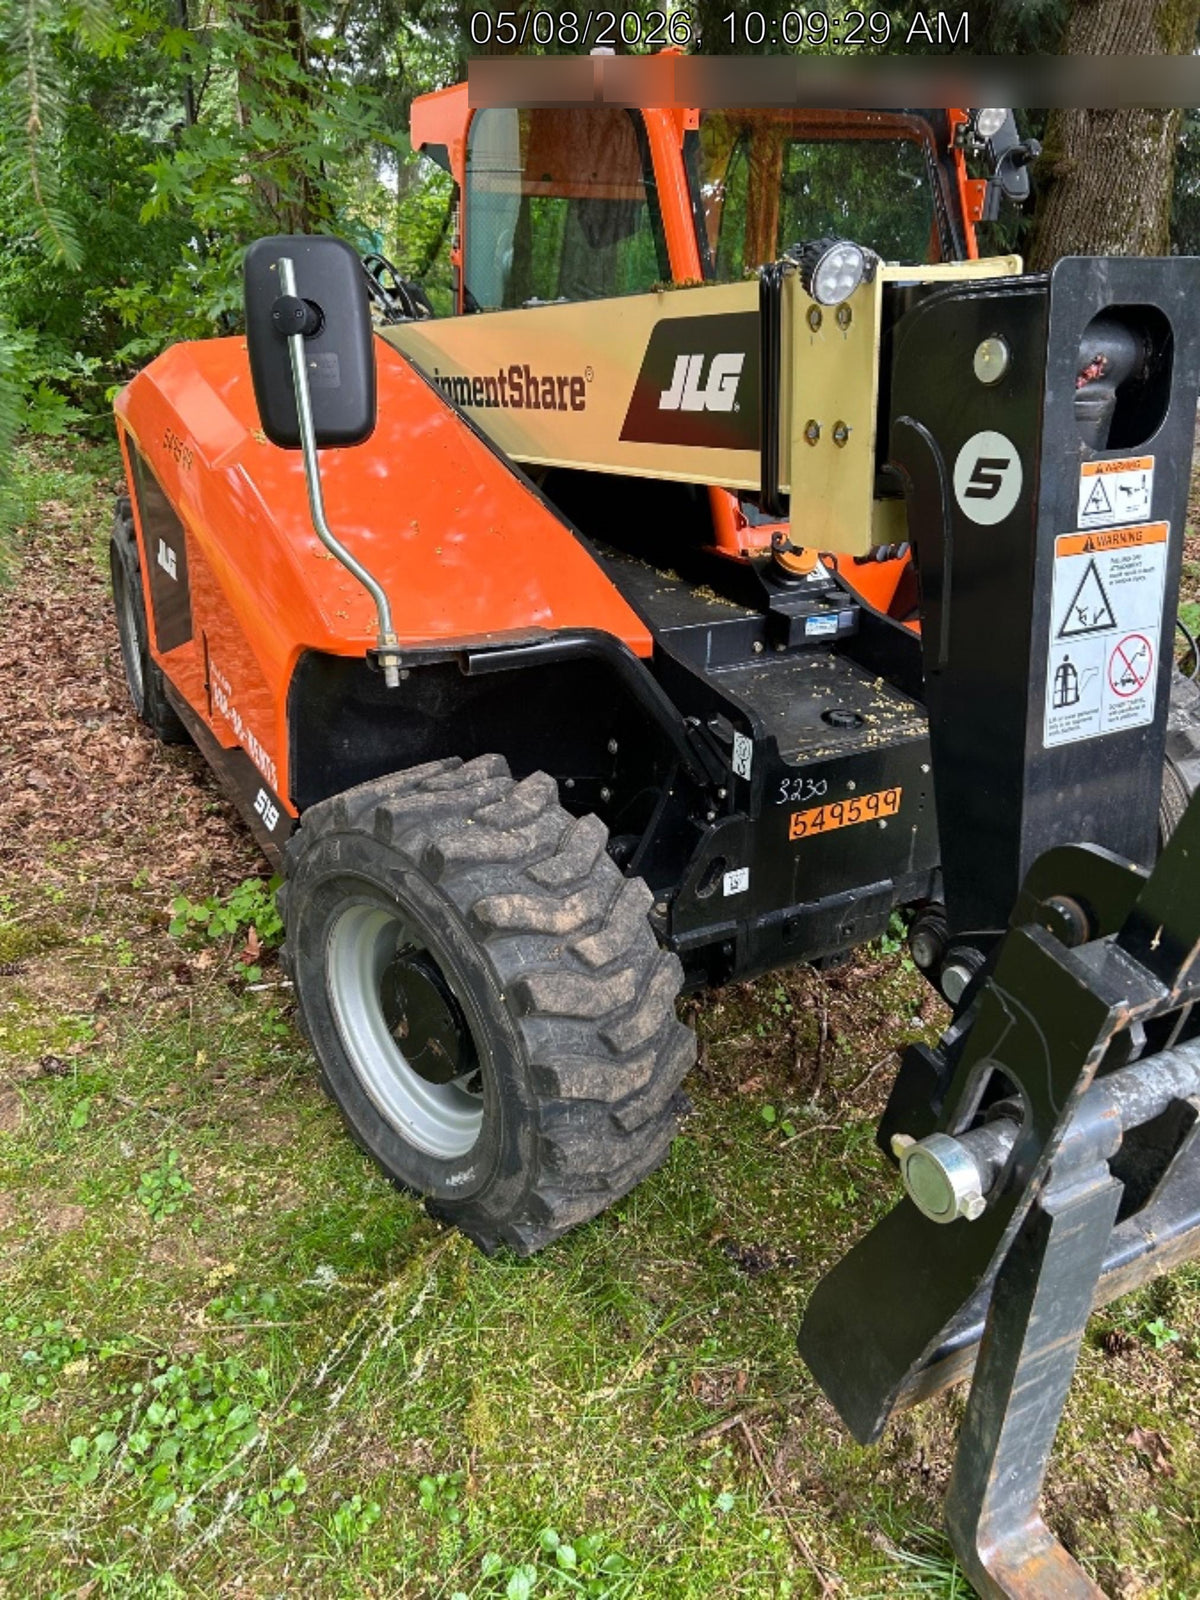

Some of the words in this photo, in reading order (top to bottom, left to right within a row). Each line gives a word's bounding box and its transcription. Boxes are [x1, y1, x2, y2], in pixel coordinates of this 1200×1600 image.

[658, 352, 746, 412] JLG
[157, 537, 178, 581] JLG
[1096, 530, 1143, 547] WARNING
[776, 778, 828, 805] 3230
[792, 790, 898, 837] 549599
